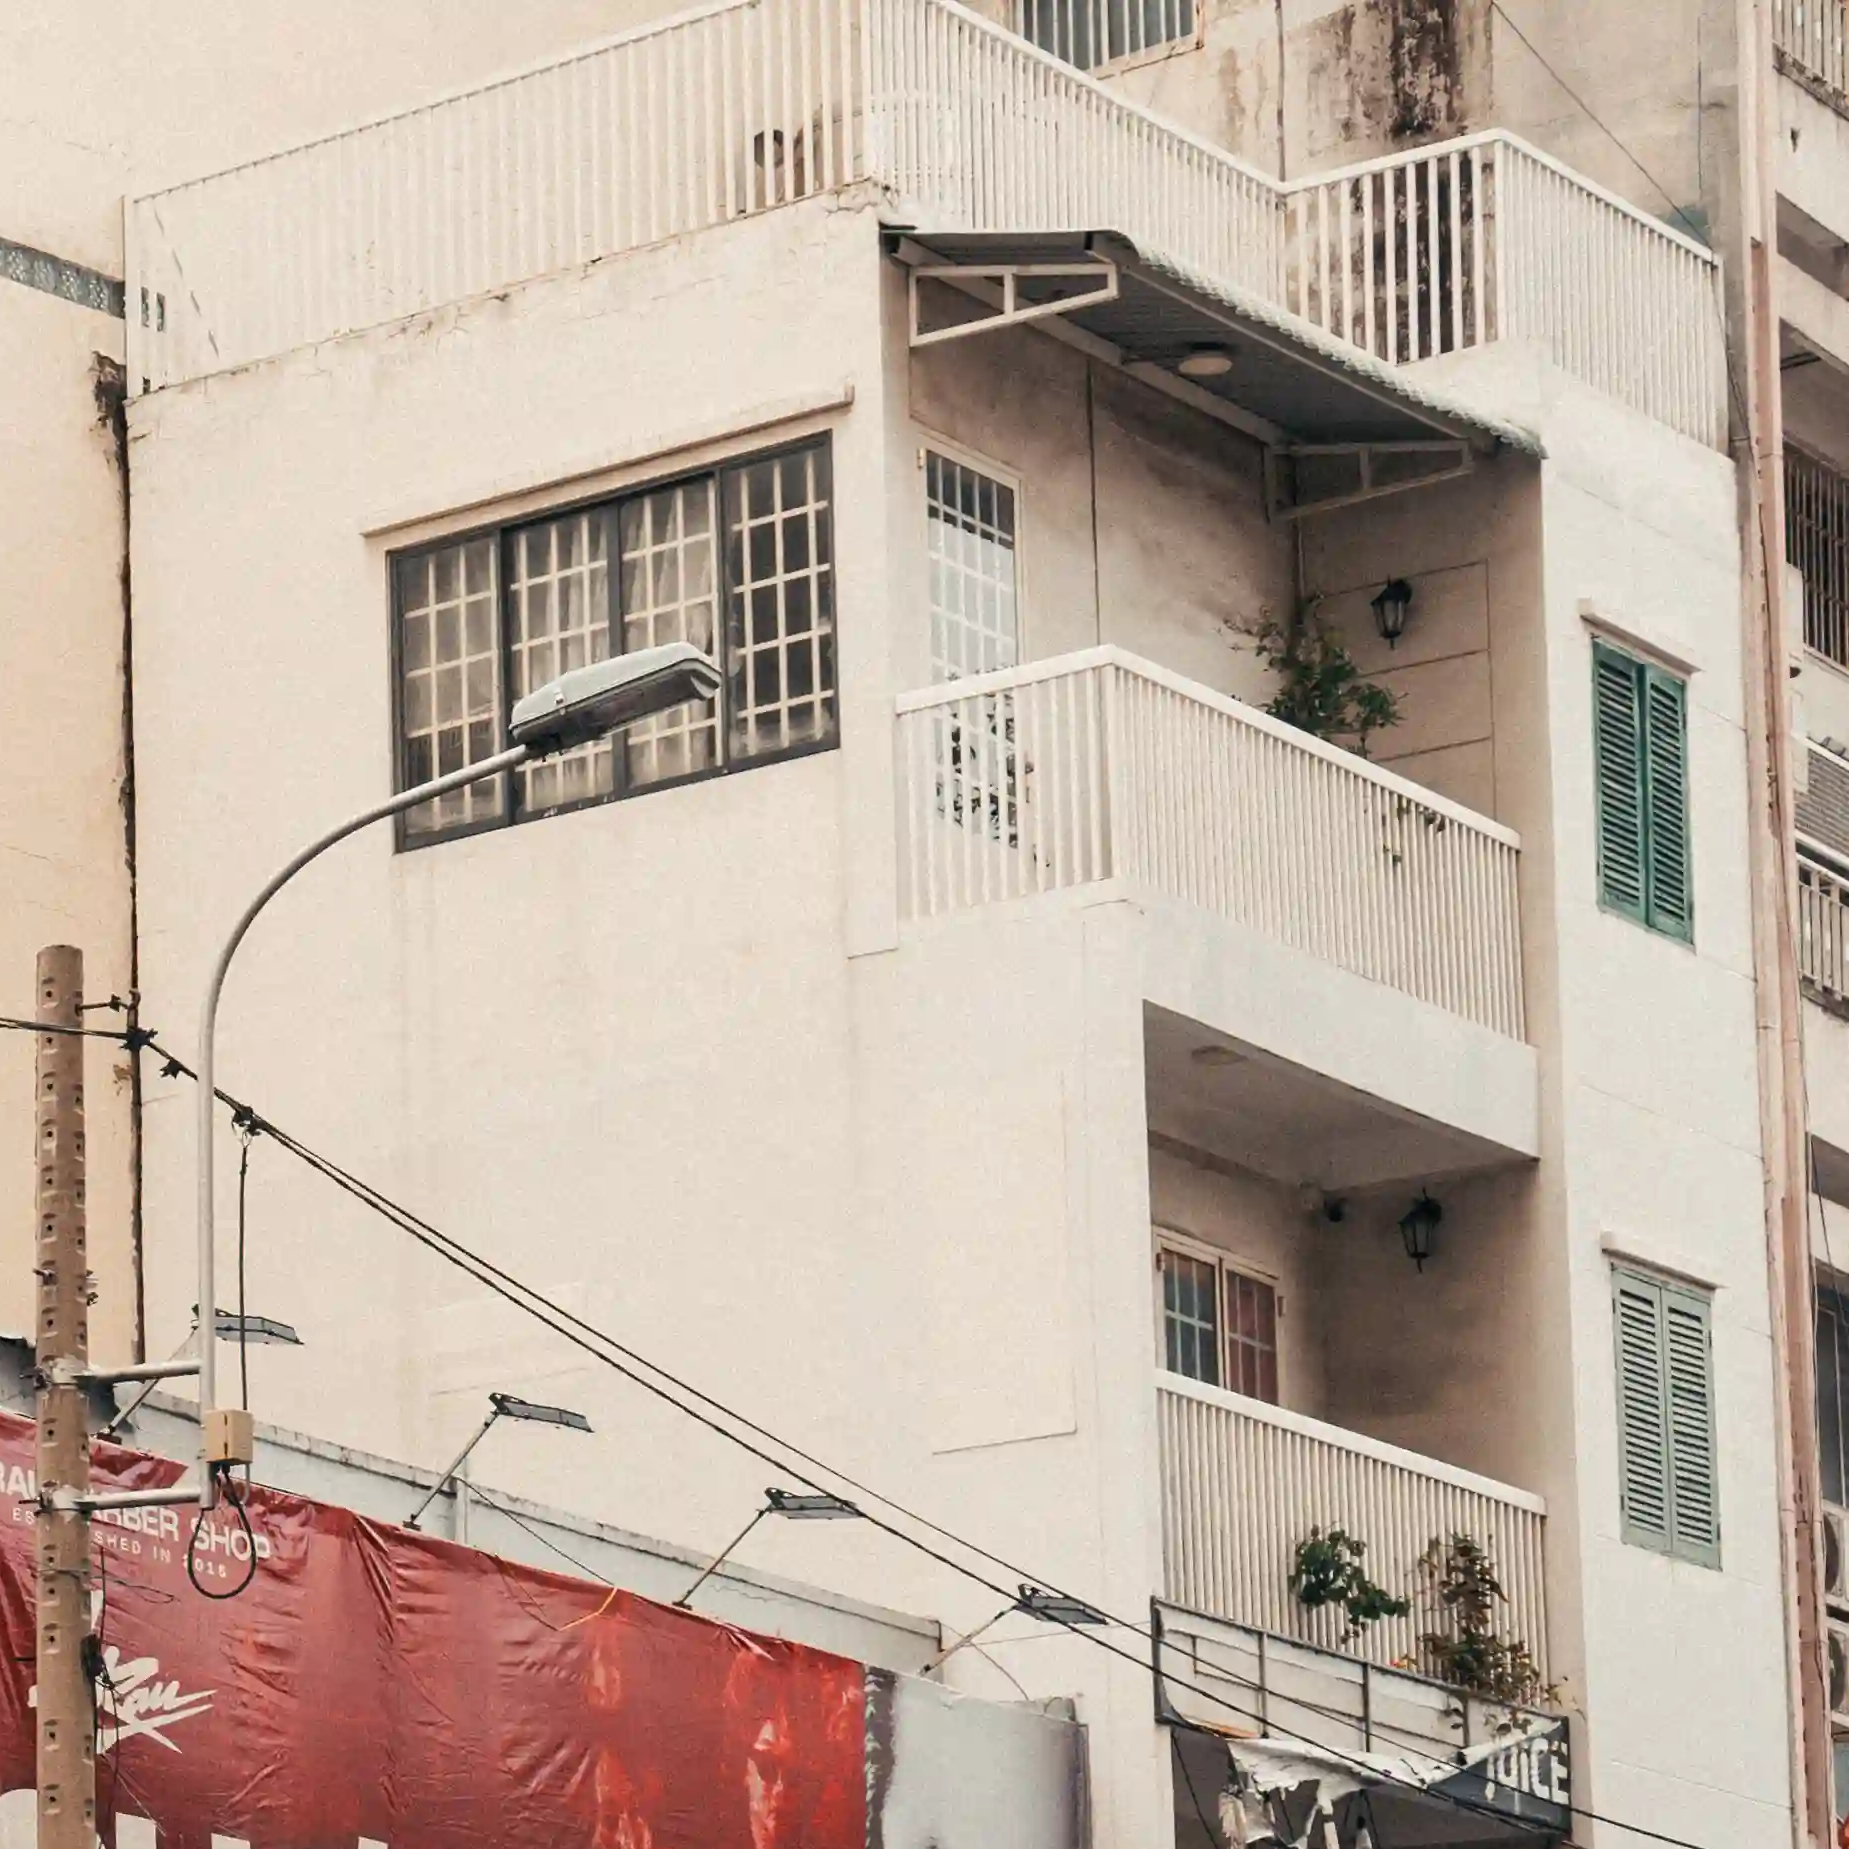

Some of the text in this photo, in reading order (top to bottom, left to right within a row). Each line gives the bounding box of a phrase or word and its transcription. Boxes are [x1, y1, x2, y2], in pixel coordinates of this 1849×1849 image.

[12, 1507, 142, 1556] ESSHED
[153, 1545, 171, 1564] IN
[190, 1516, 271, 1562] SHOP
